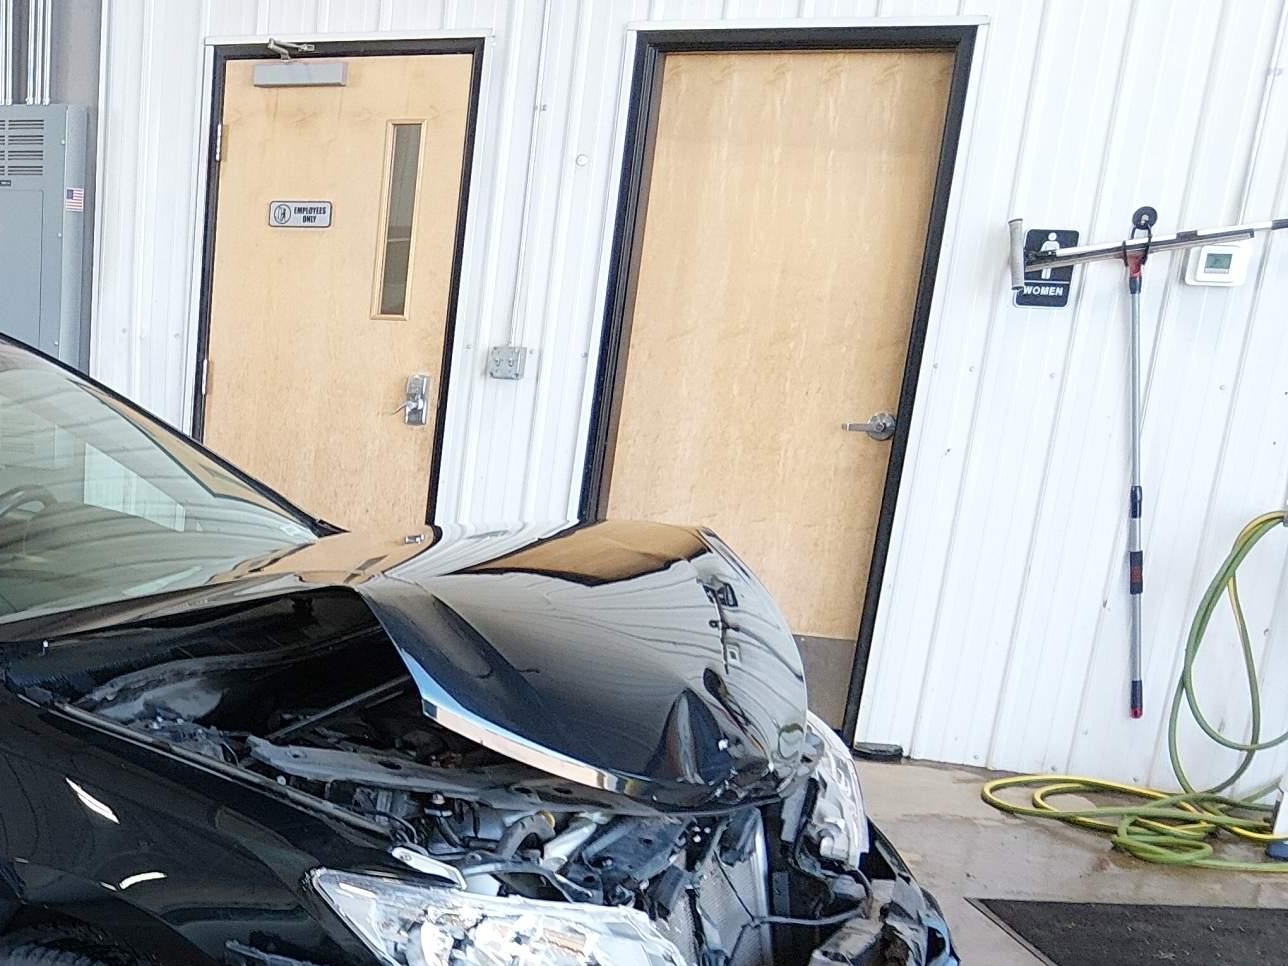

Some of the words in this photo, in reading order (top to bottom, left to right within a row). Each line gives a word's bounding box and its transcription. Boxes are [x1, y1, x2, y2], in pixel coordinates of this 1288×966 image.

[293, 206, 327, 215] EMPLOYEES
[302, 215, 317, 223] ONLY
[1022, 285, 1064, 296] WOMEN
